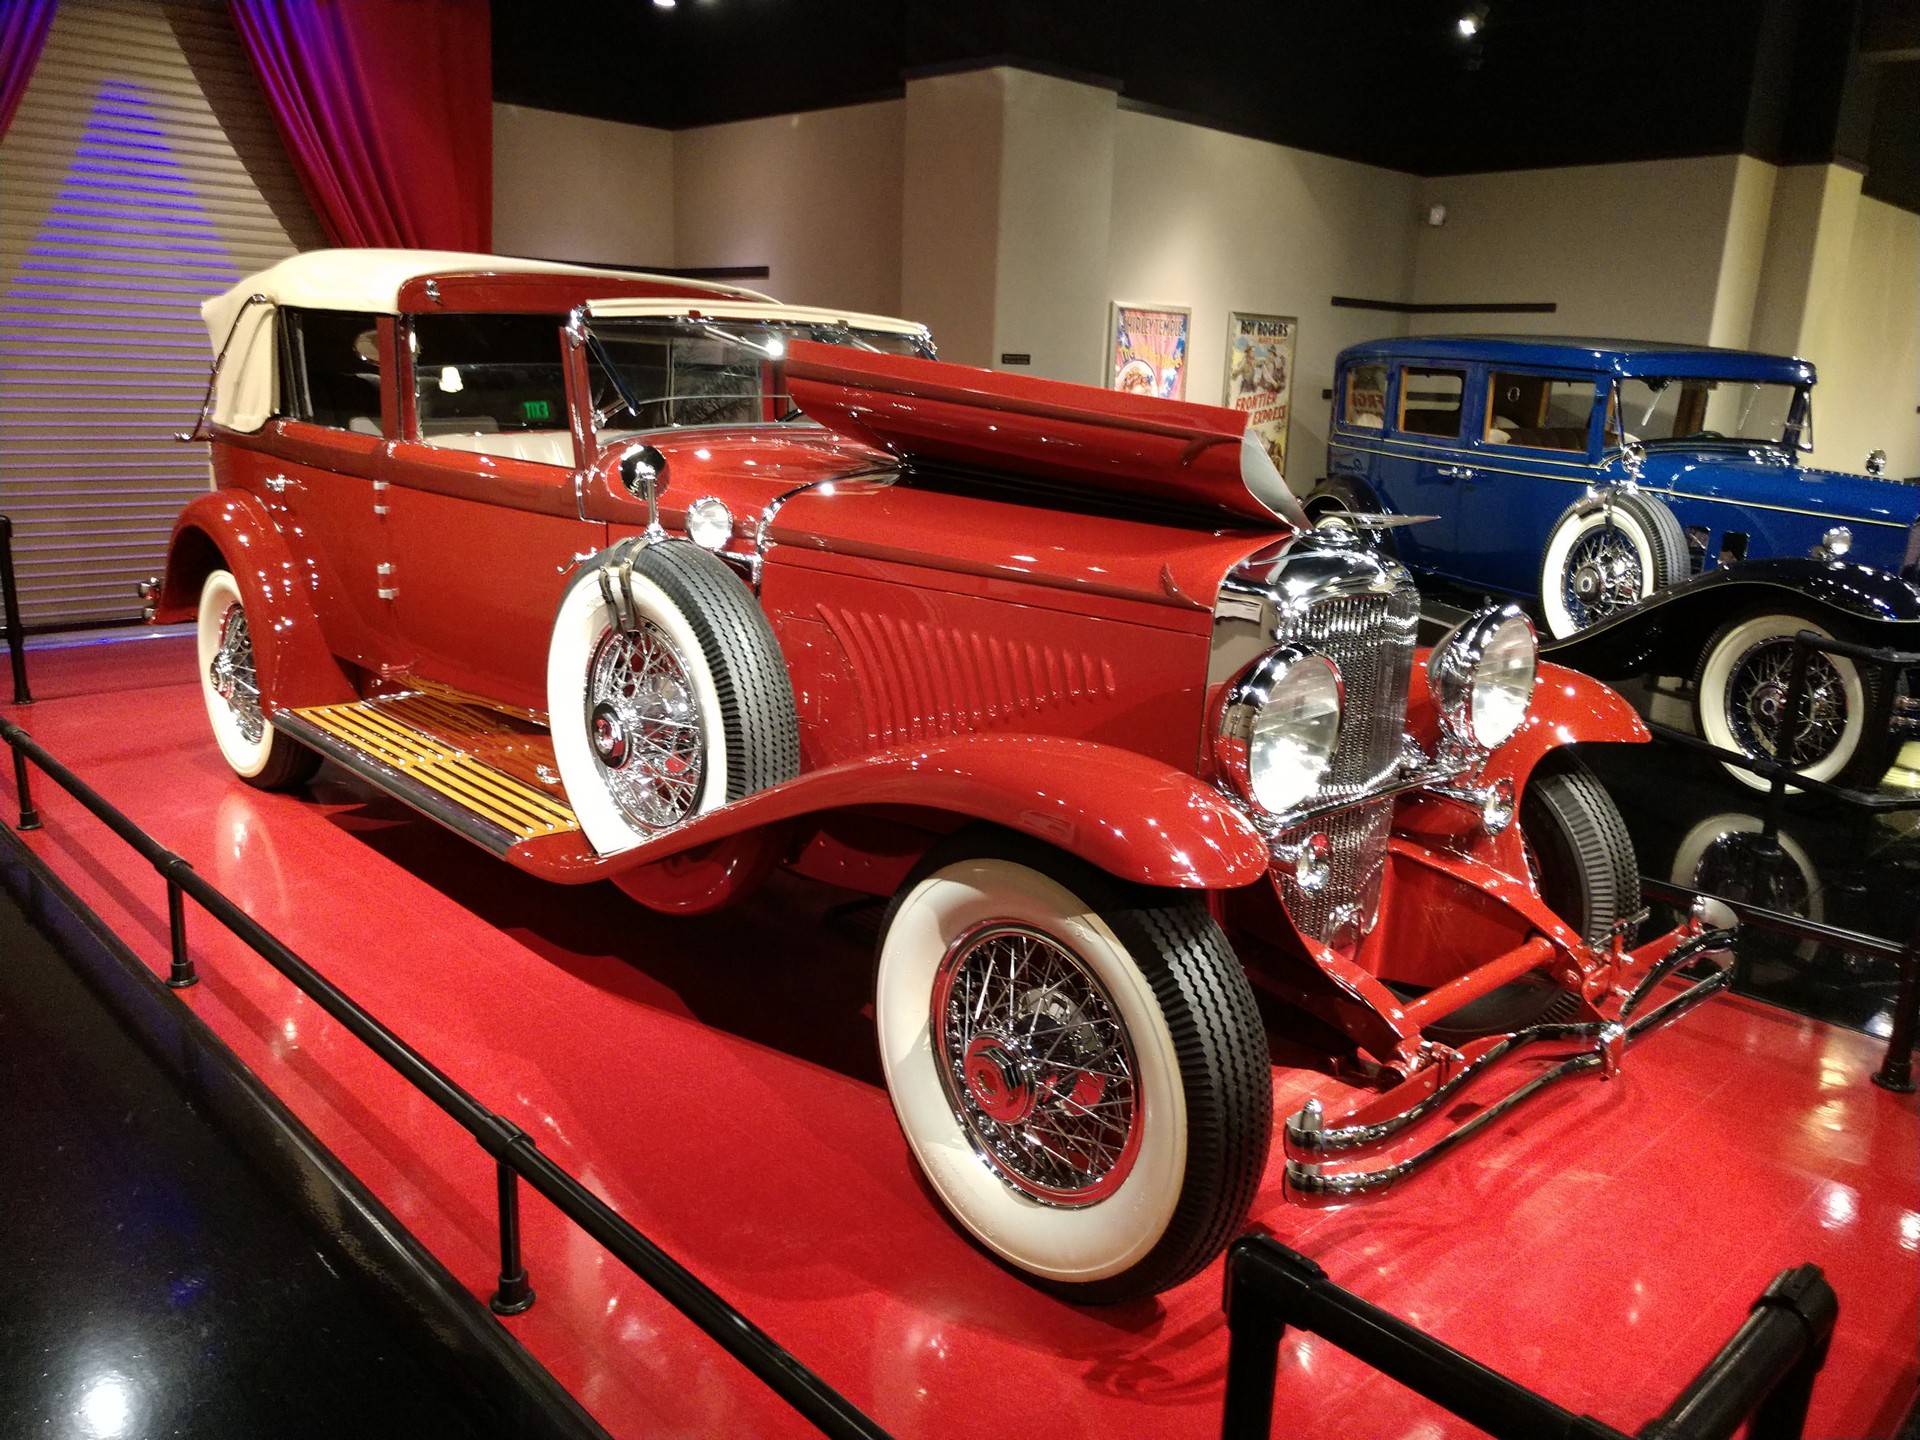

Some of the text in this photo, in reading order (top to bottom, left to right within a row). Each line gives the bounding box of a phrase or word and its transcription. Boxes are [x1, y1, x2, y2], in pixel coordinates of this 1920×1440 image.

[1122, 315, 1183, 337] SHIRLEY TEMPLE
[1241, 321, 1288, 337] ROY ROGERS
[1119, 345, 1135, 361] The
[1236, 392, 1277, 412] FRONTIER
[1253, 405, 1287, 426] EXPRESS
